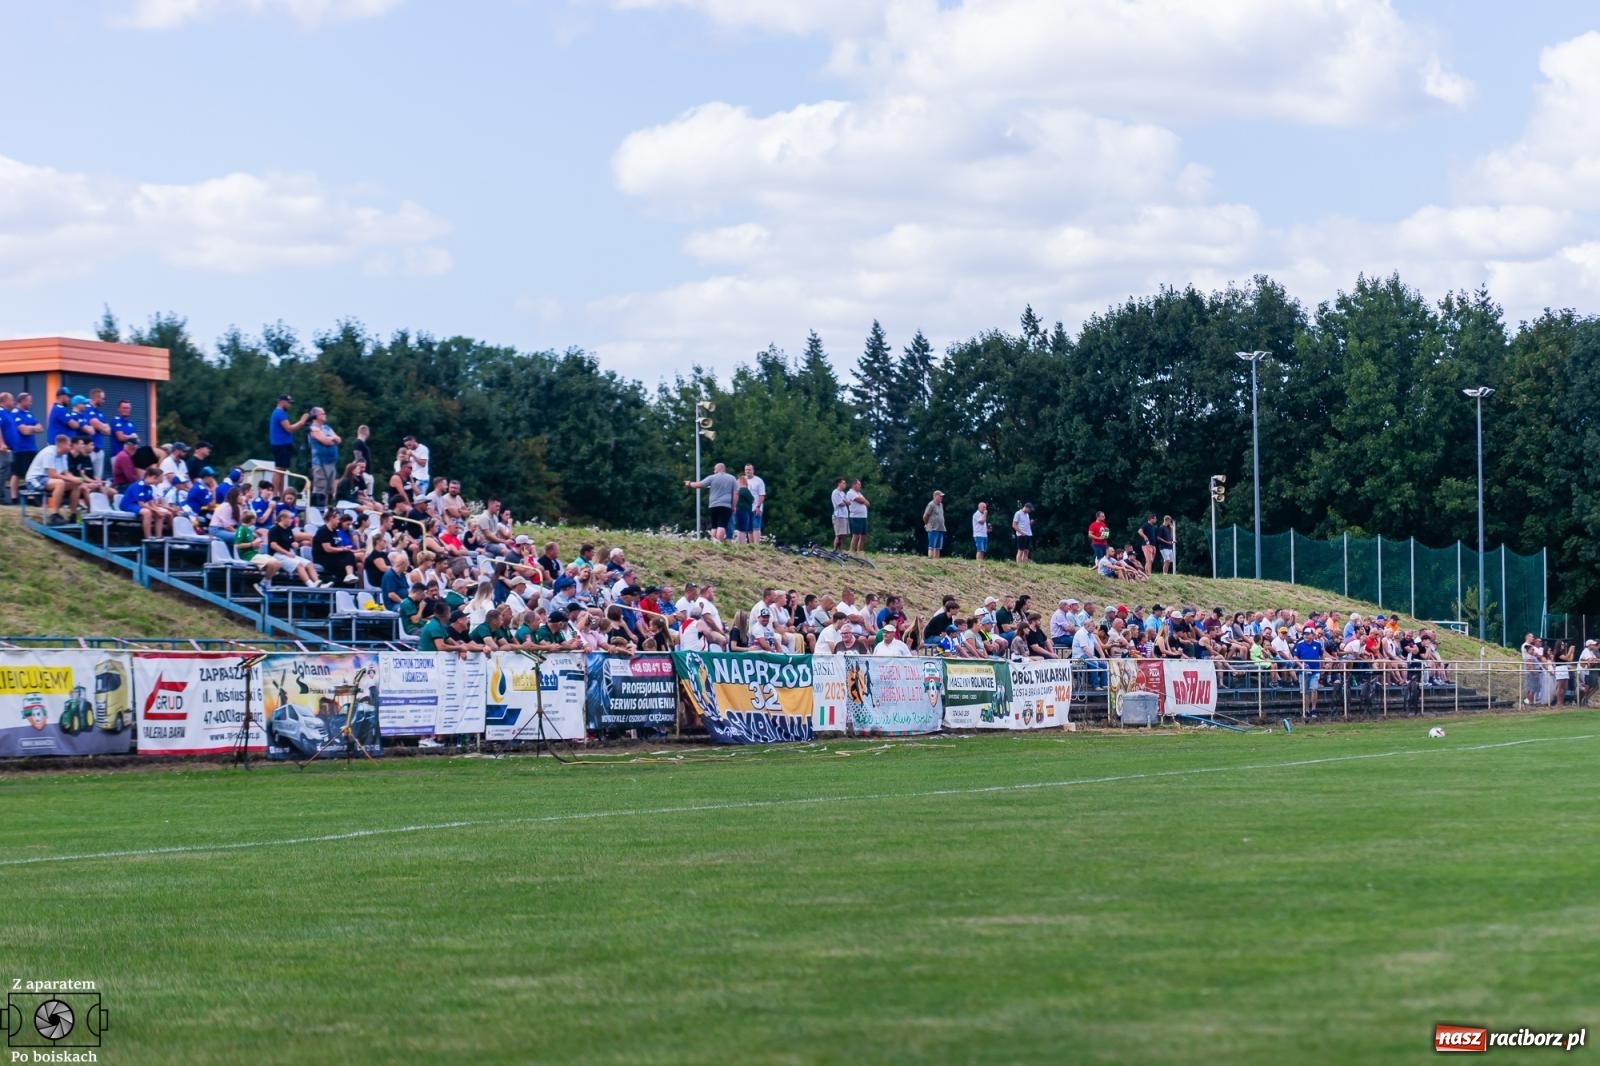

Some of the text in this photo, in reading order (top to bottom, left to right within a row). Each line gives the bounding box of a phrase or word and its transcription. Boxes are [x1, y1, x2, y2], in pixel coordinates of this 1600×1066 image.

[292, 661, 331, 678] Johann
[712, 657, 812, 688] NAPRZÓD
[1012, 667, 1034, 685] OBÓZ
[1036, 667, 1071, 683] PIŁKARSKI
[610, 698, 636, 710] SERWIS
[748, 681, 782, 711] 32
